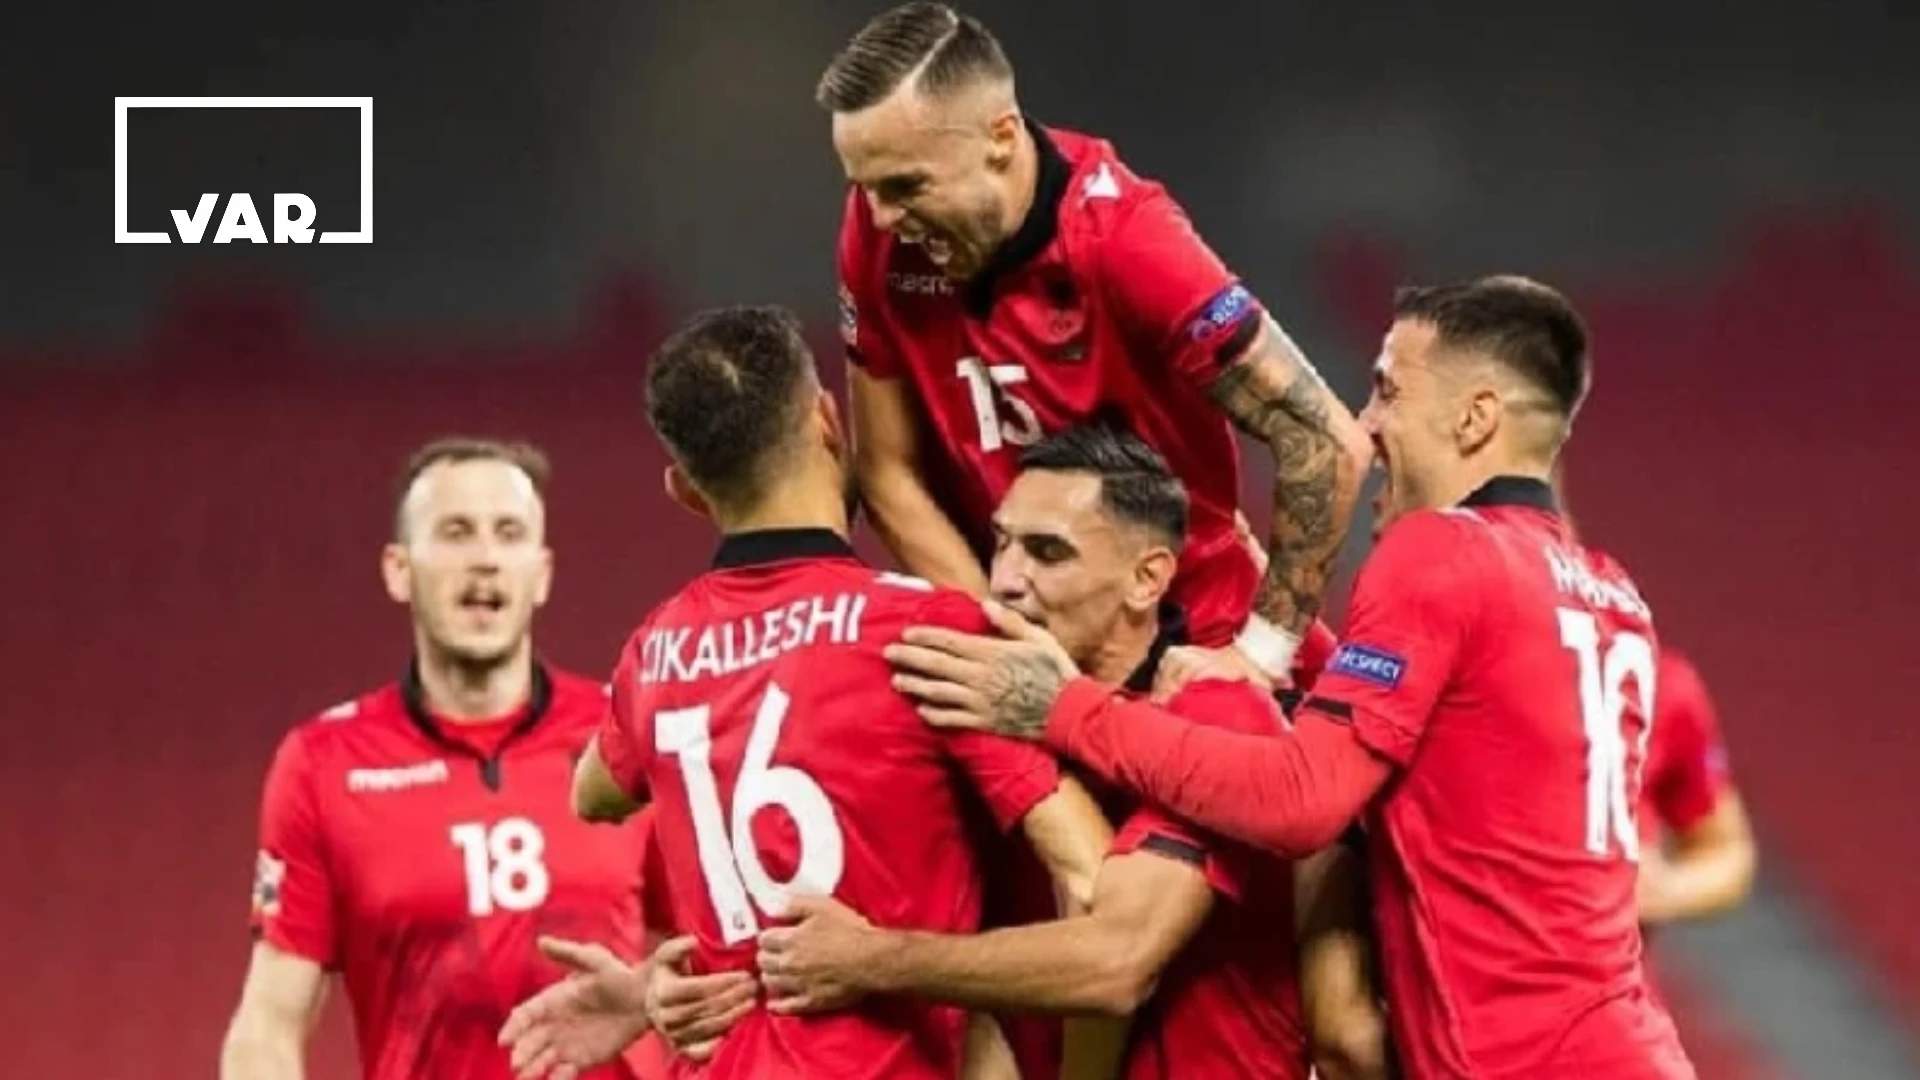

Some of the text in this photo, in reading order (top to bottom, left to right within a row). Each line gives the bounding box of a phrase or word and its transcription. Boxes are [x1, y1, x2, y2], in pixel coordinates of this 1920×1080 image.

[956, 356, 1042, 452] 15
[655, 681, 845, 947] 16
[1556, 606, 1656, 863] 10
[450, 816, 550, 917] 18
